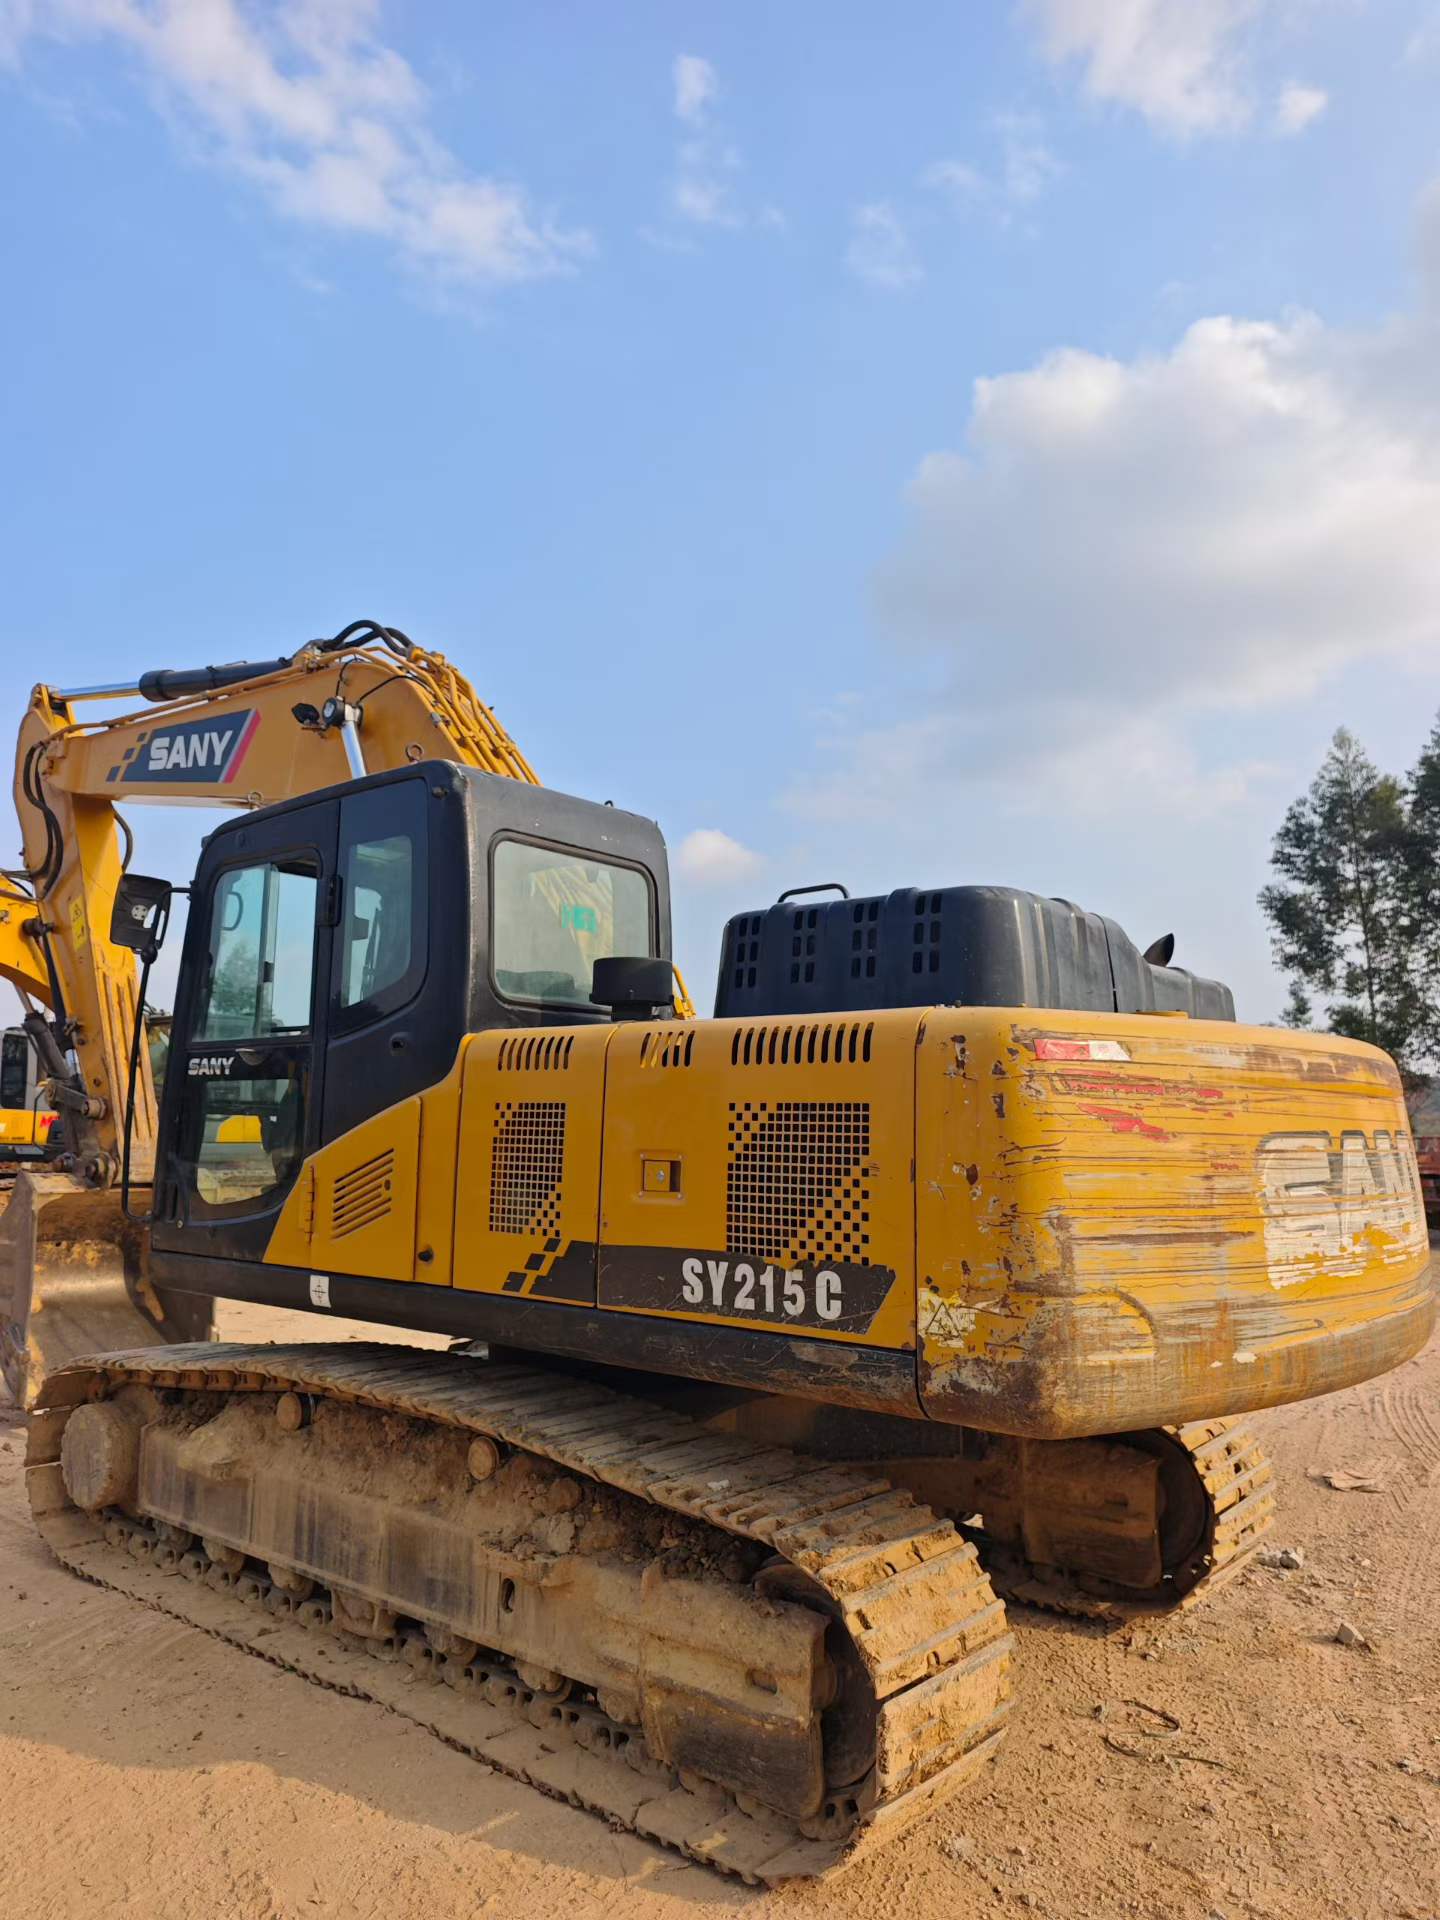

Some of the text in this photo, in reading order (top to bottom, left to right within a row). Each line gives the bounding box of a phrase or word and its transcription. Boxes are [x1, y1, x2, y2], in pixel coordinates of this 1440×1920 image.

[148, 730, 234, 771] SANY
[188, 1057, 235, 1075] SANY
[1256, 1130, 1427, 1289] SAN
[682, 1257, 842, 1321] SY215C
